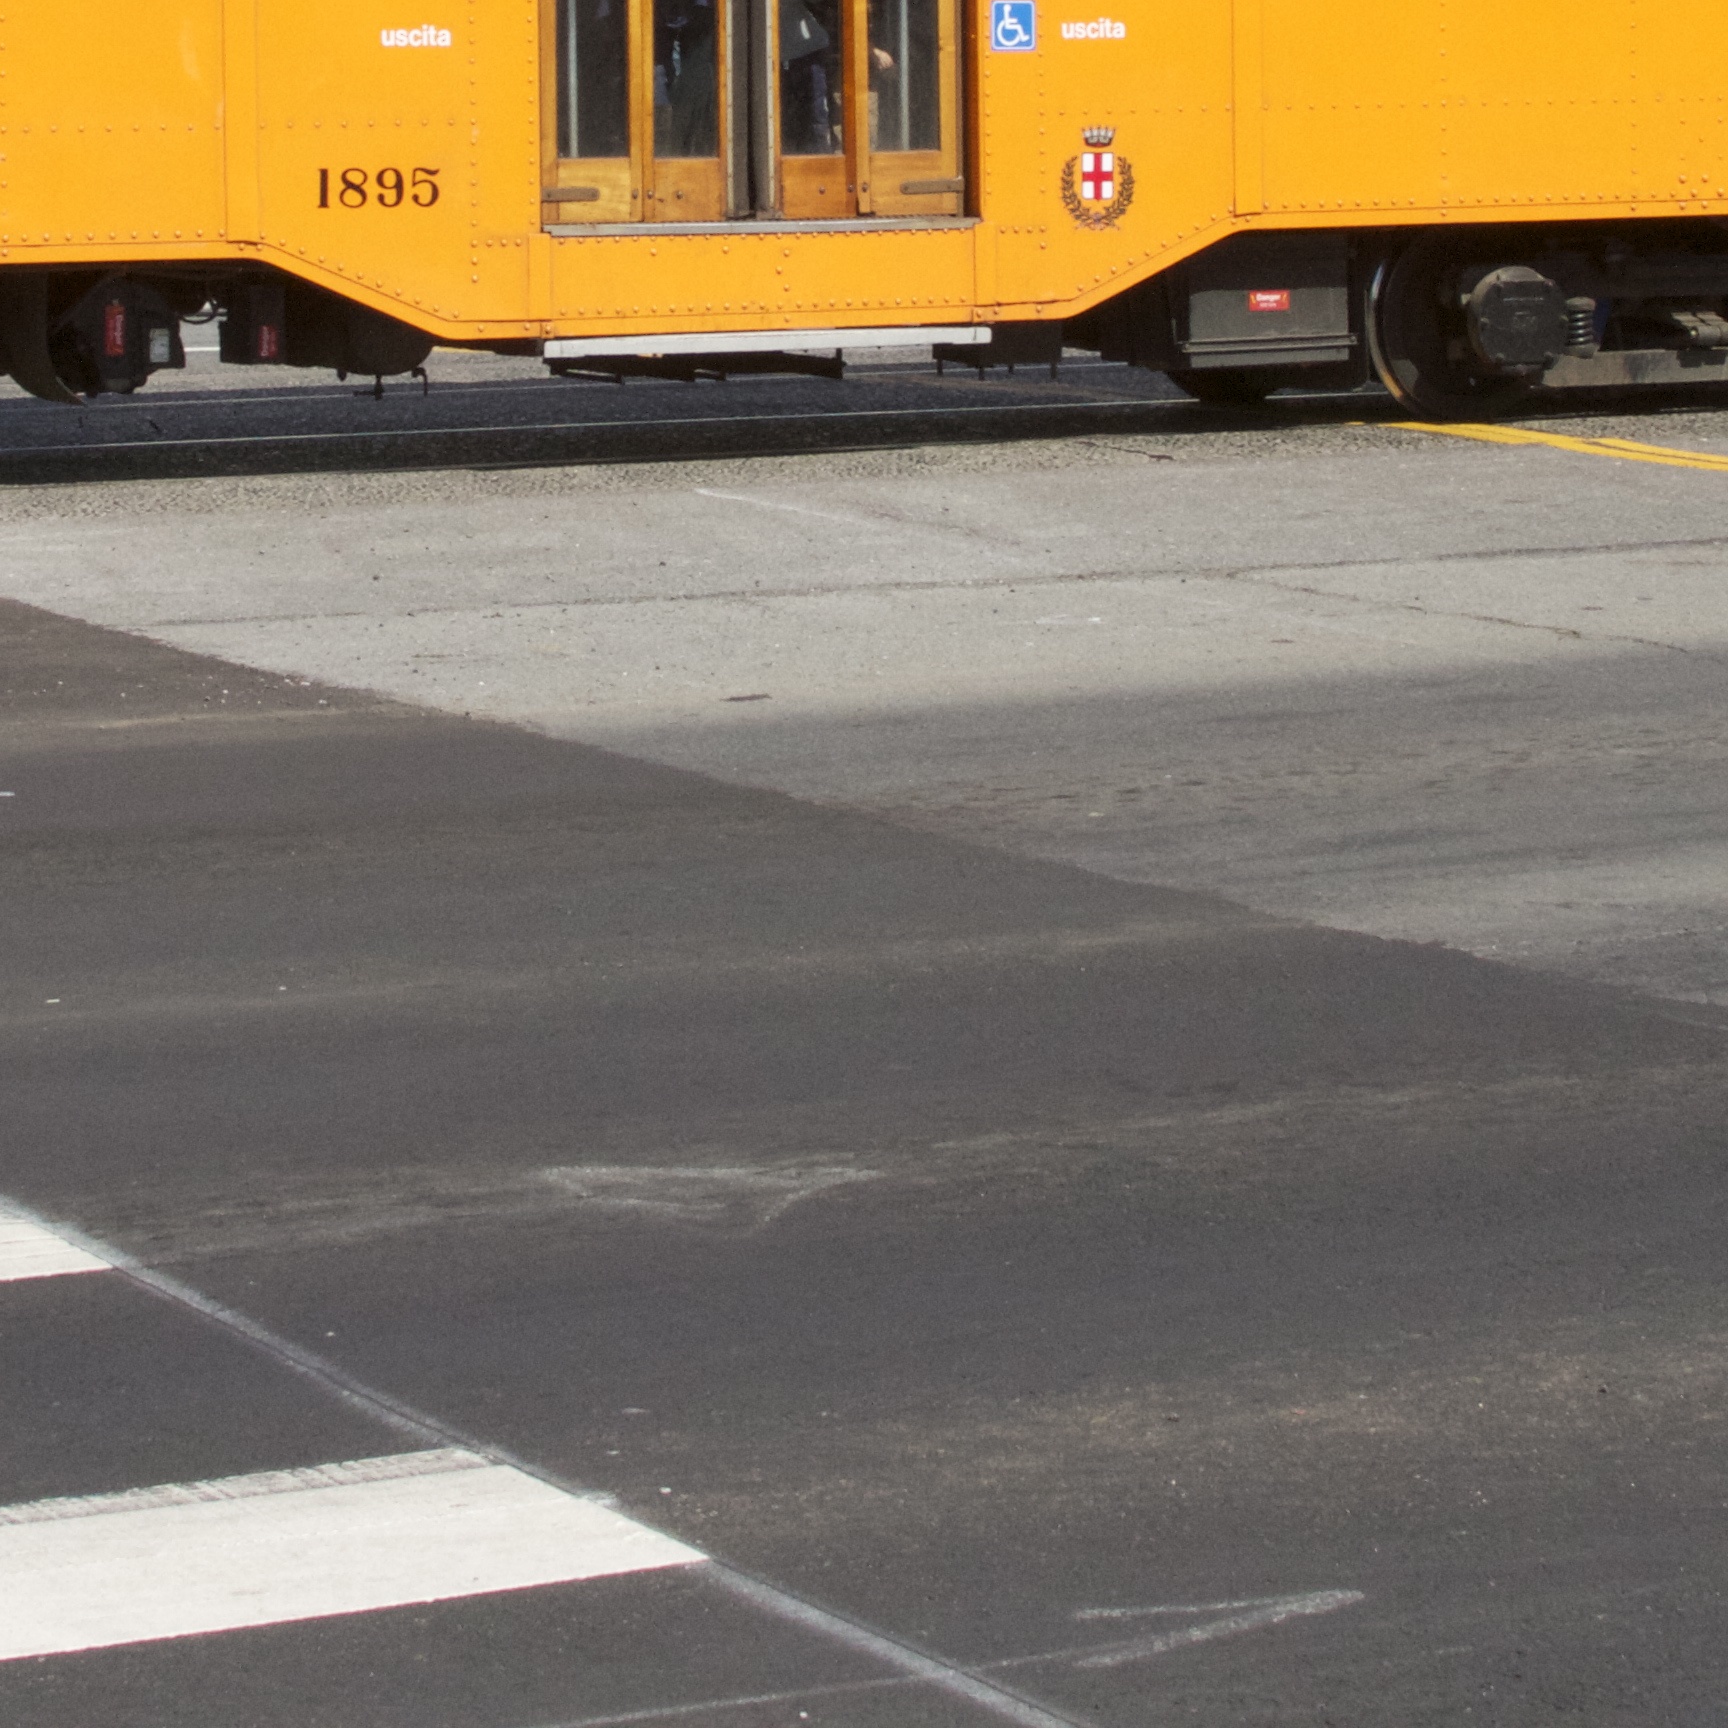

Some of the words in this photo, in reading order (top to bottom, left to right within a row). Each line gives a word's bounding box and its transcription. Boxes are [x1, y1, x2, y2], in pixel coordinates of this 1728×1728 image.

[380, 24, 452, 47] uscita
[1060, 17, 1126, 40] uscita
[317, 166, 441, 209] 1895
